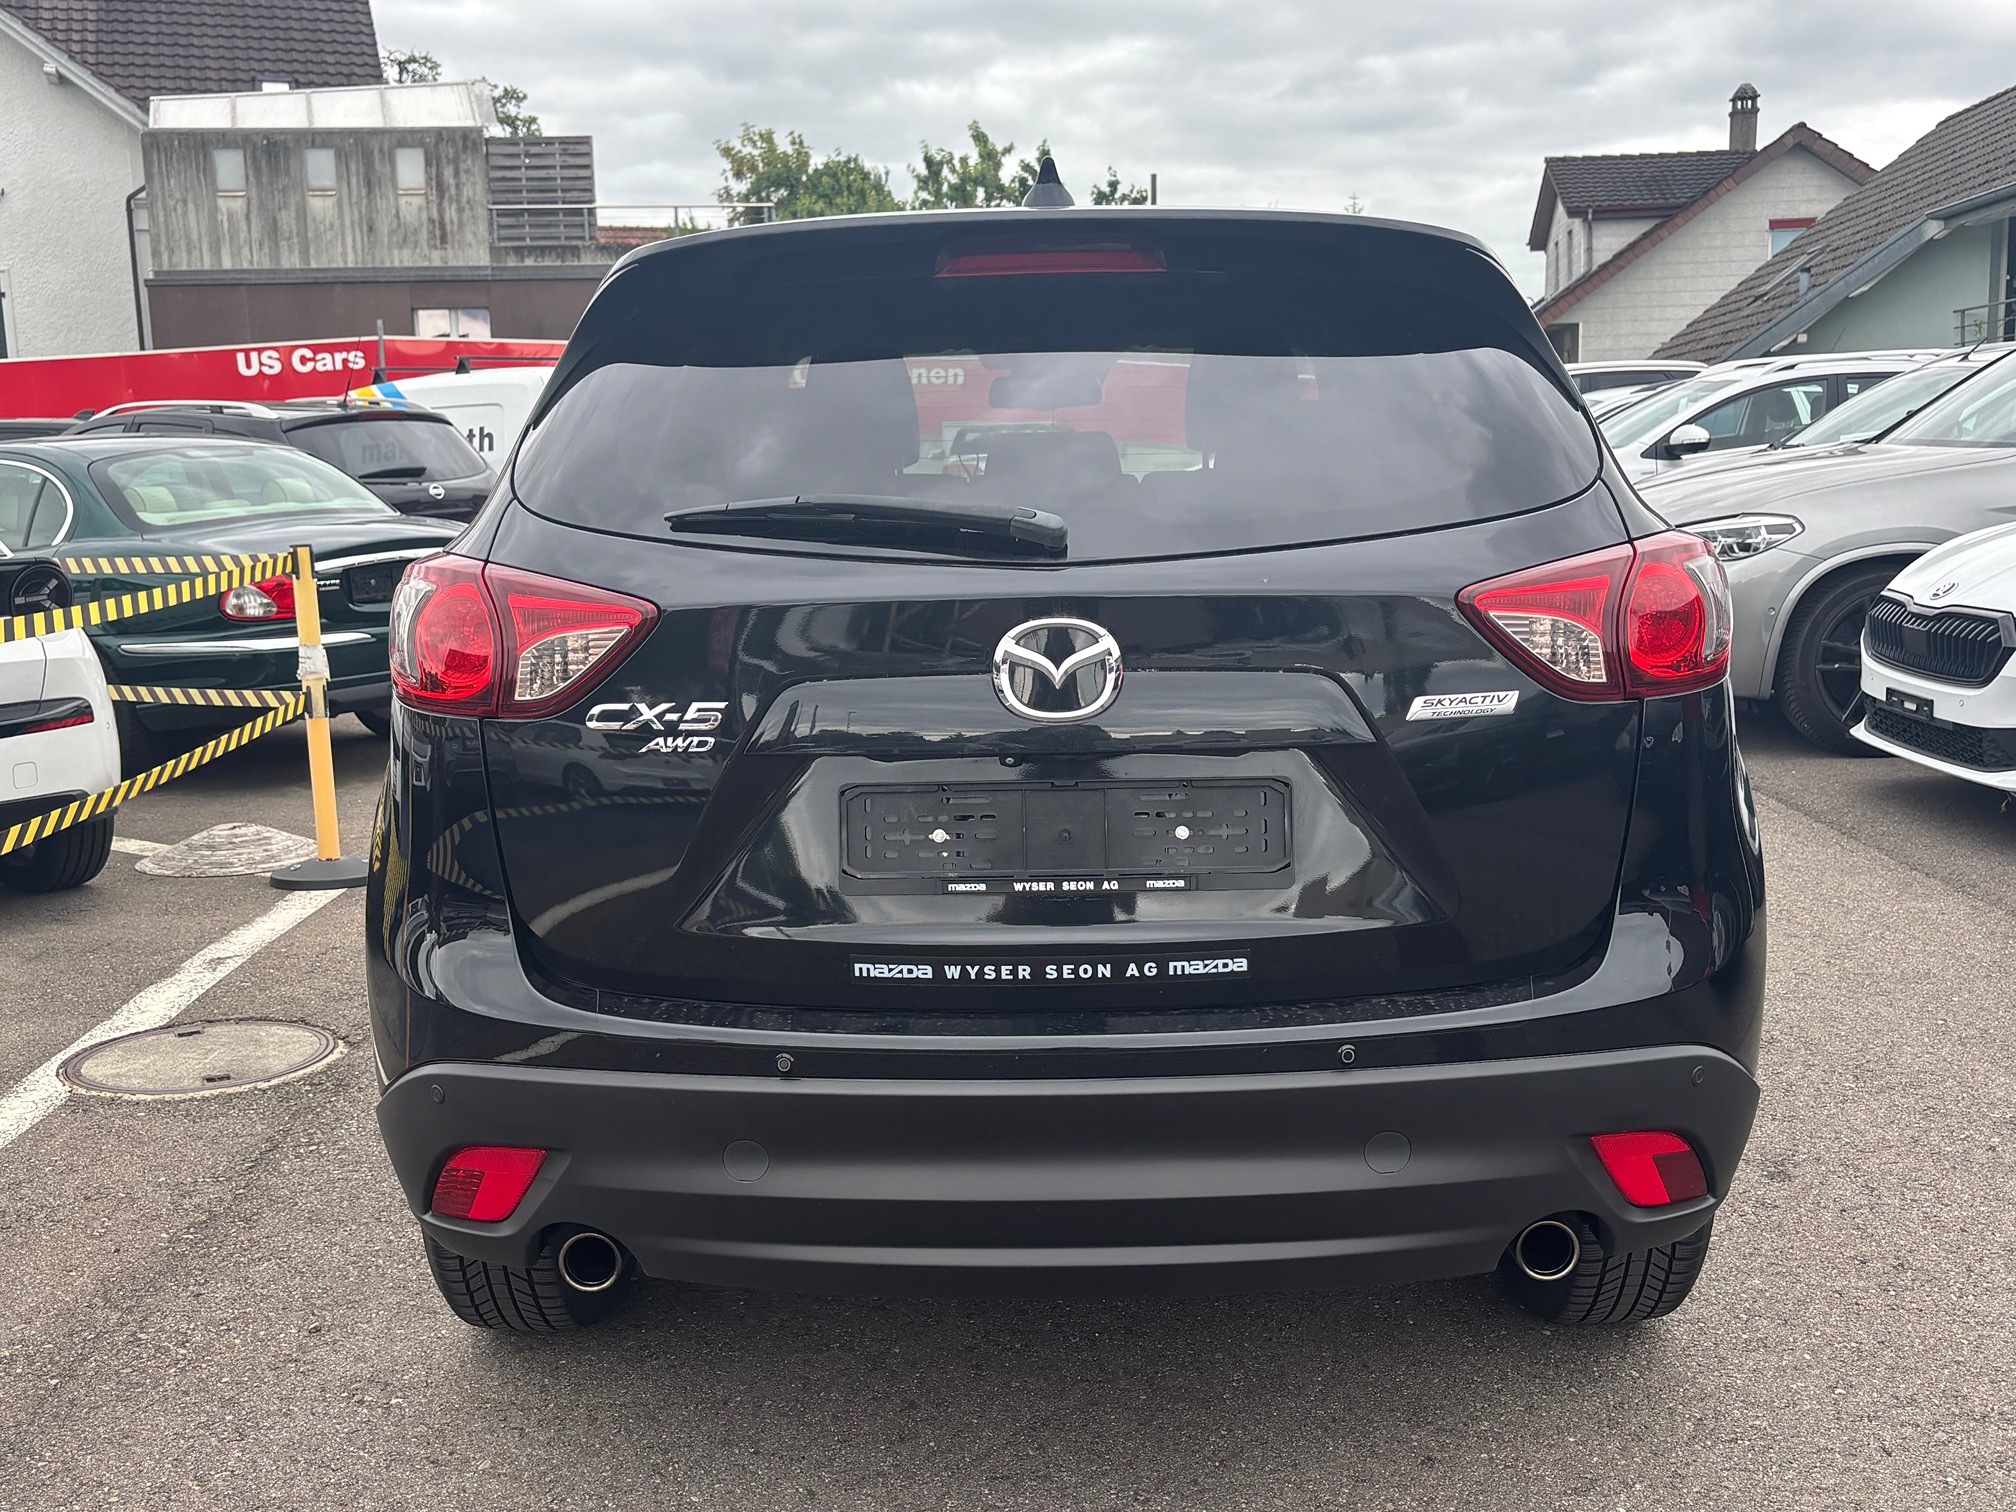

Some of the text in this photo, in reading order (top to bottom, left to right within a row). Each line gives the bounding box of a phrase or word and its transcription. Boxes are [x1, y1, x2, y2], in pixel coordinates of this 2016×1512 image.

[236, 347, 366, 377] US Cars
[911, 367, 965, 384] nen
[1421, 693, 1509, 708] SKYACTIV
[585, 701, 729, 731] CX-5
[1430, 707, 1498, 717] TECHNOLOGY
[638, 735, 716, 754] AWD
[1013, 881, 1055, 892] WYSER
[1062, 880, 1095, 891] SEON
[1101, 880, 1119, 890] AG
[943, 964, 1032, 980] WYSER
[1045, 963, 1112, 980] SEON
[1125, 962, 1158, 978] AG
